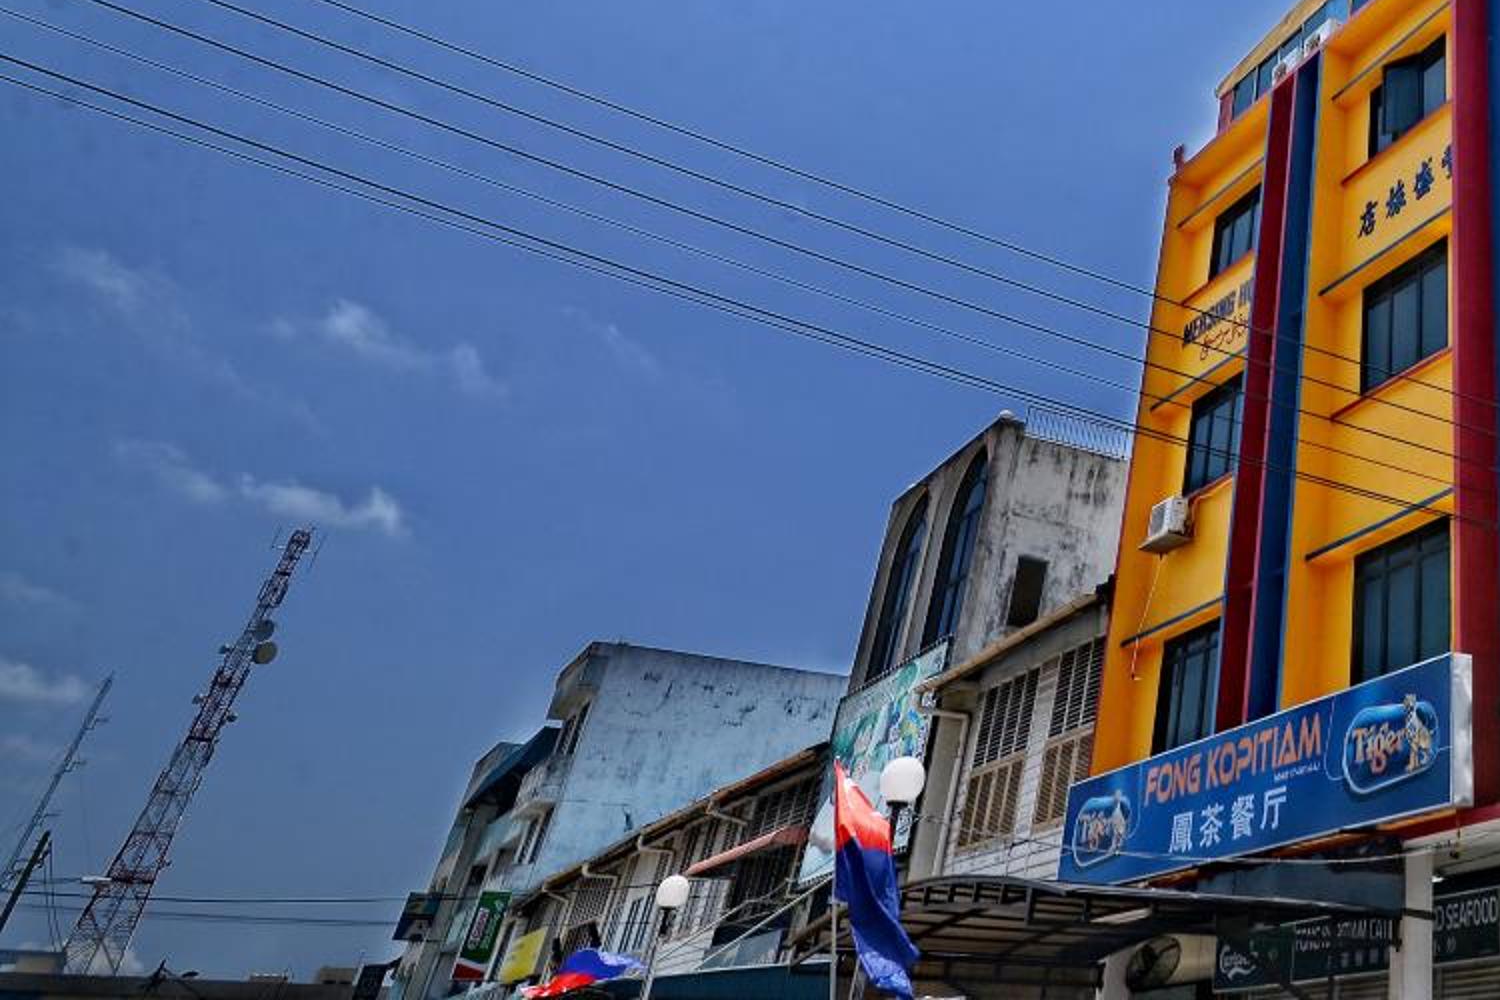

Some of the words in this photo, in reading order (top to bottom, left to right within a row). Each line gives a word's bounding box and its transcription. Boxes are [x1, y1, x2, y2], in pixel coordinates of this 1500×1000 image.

[1144, 753, 1201, 808] FONG
[1206, 712, 1321, 791] KOPITIAM
[1352, 721, 1409, 775] Tiger
[1445, 896, 1498, 930] SEAFOOD
